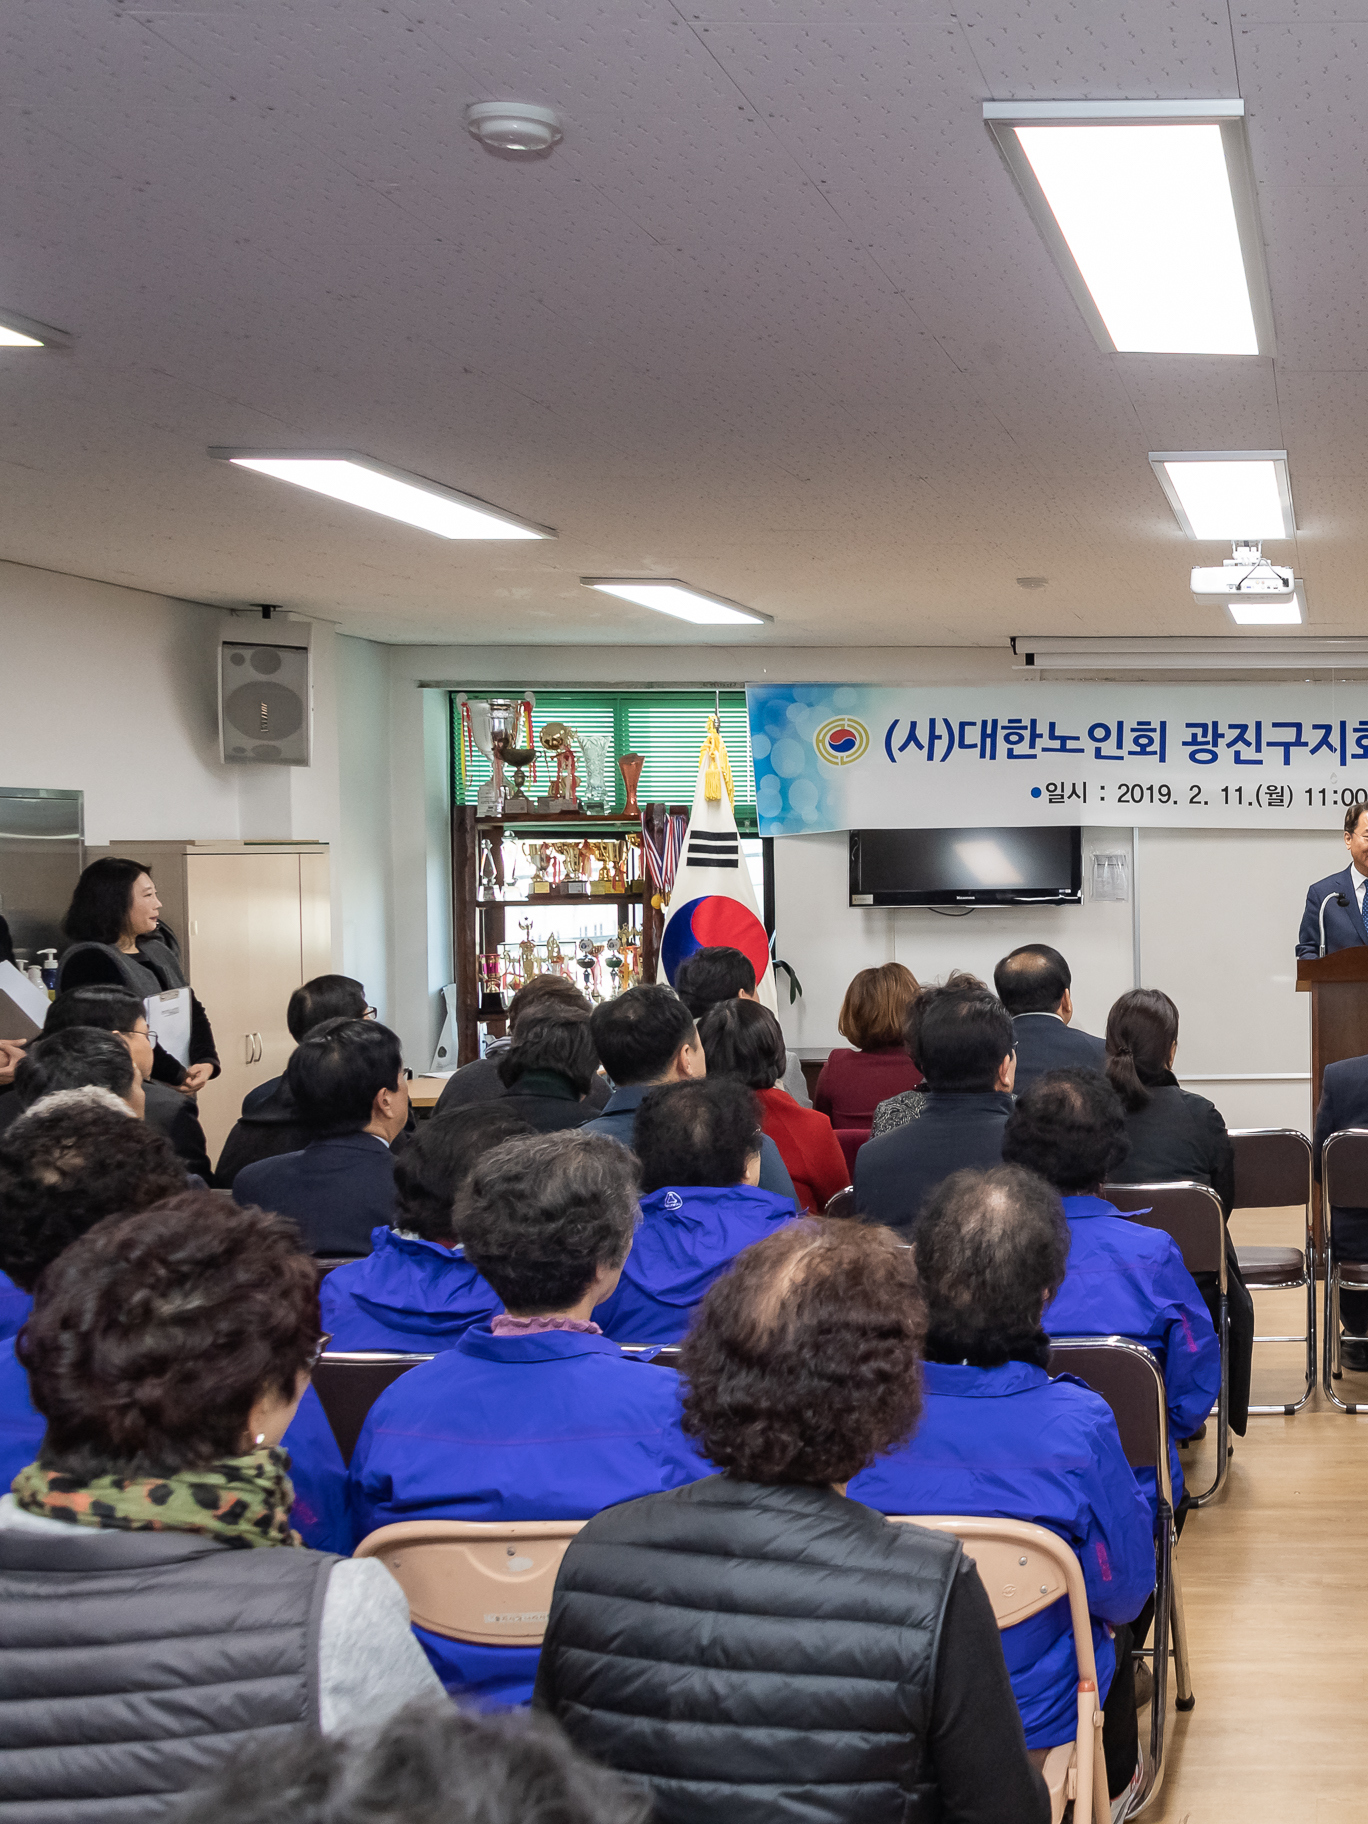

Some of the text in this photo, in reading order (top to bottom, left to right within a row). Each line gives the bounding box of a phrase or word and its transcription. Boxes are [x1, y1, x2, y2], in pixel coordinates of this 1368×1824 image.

[885, 717, 1167, 763] (사)대한노인회
[1045, 781, 1087, 804] 일시
[1117, 783, 1178, 805] 2019.
[1188, 784, 1209, 806] 2.
[1221, 784, 1293, 809] 11.(월)
[1304, 787, 1368, 807] 11:00
